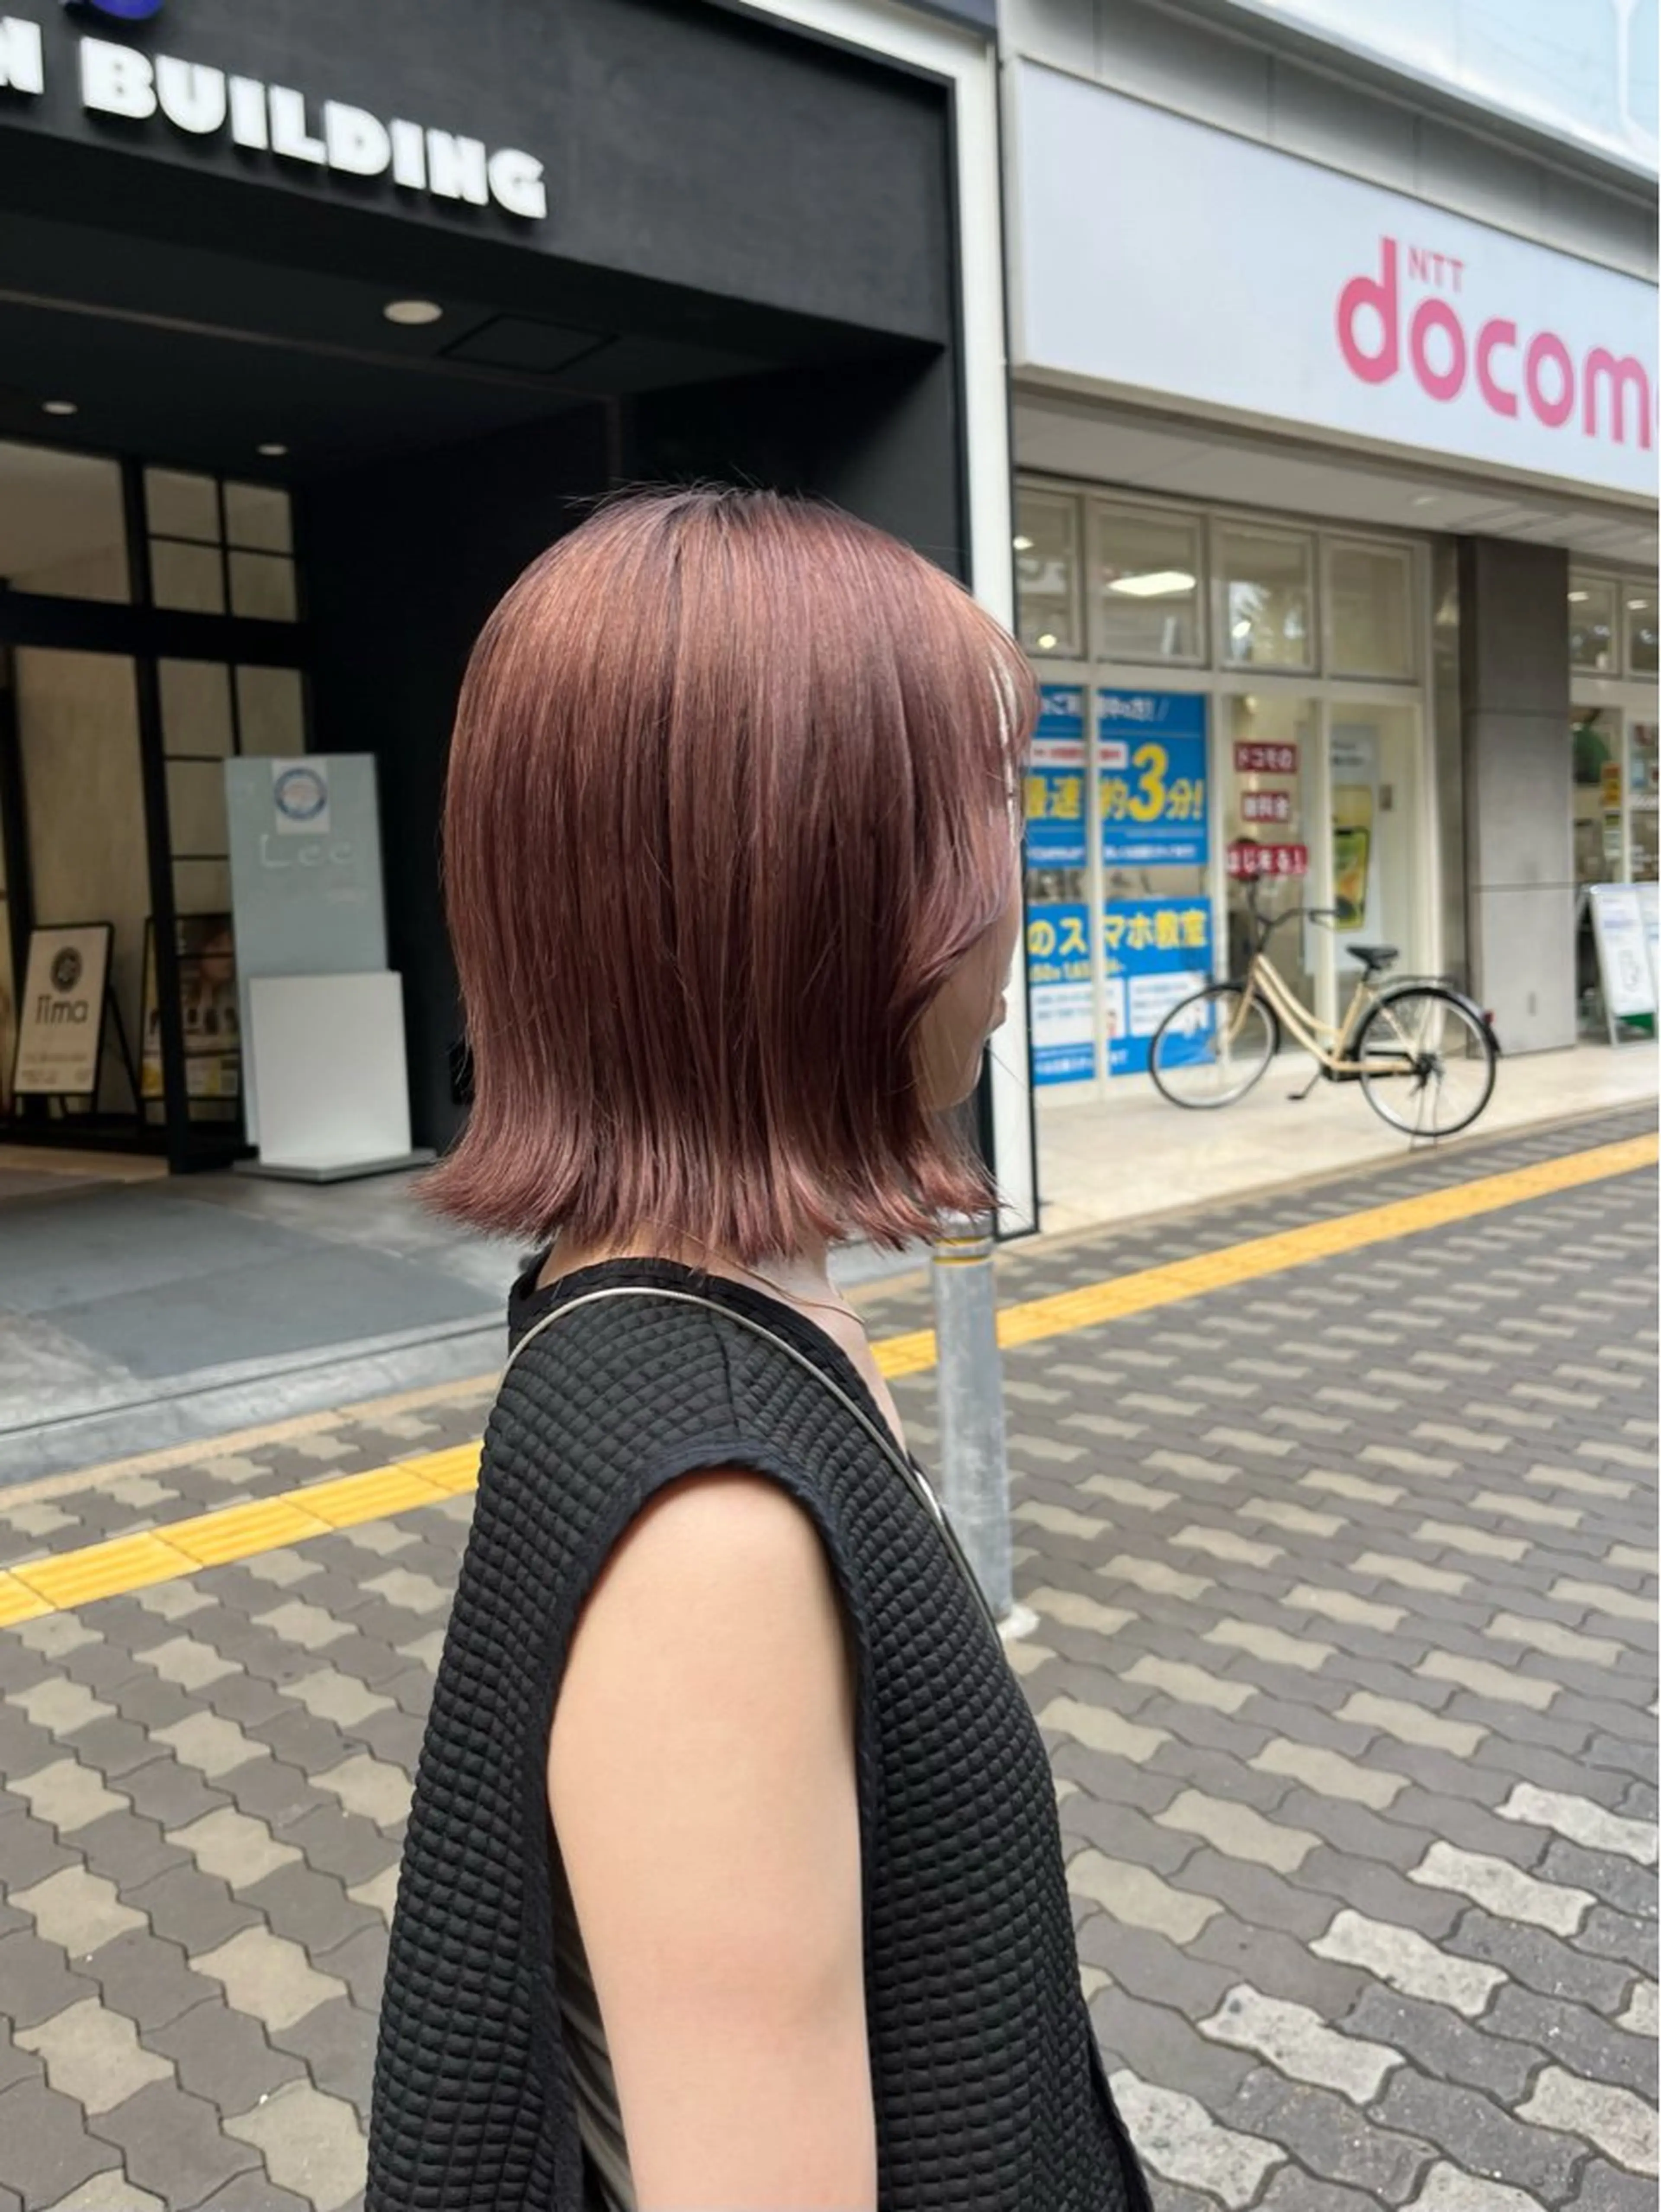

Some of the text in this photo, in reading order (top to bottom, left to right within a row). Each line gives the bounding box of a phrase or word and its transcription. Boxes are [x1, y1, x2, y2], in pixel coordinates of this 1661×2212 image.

[80, 36, 547, 219] BUILDING
[1335, 236, 1659, 451] docom
[1407, 246, 1465, 293] NTT
